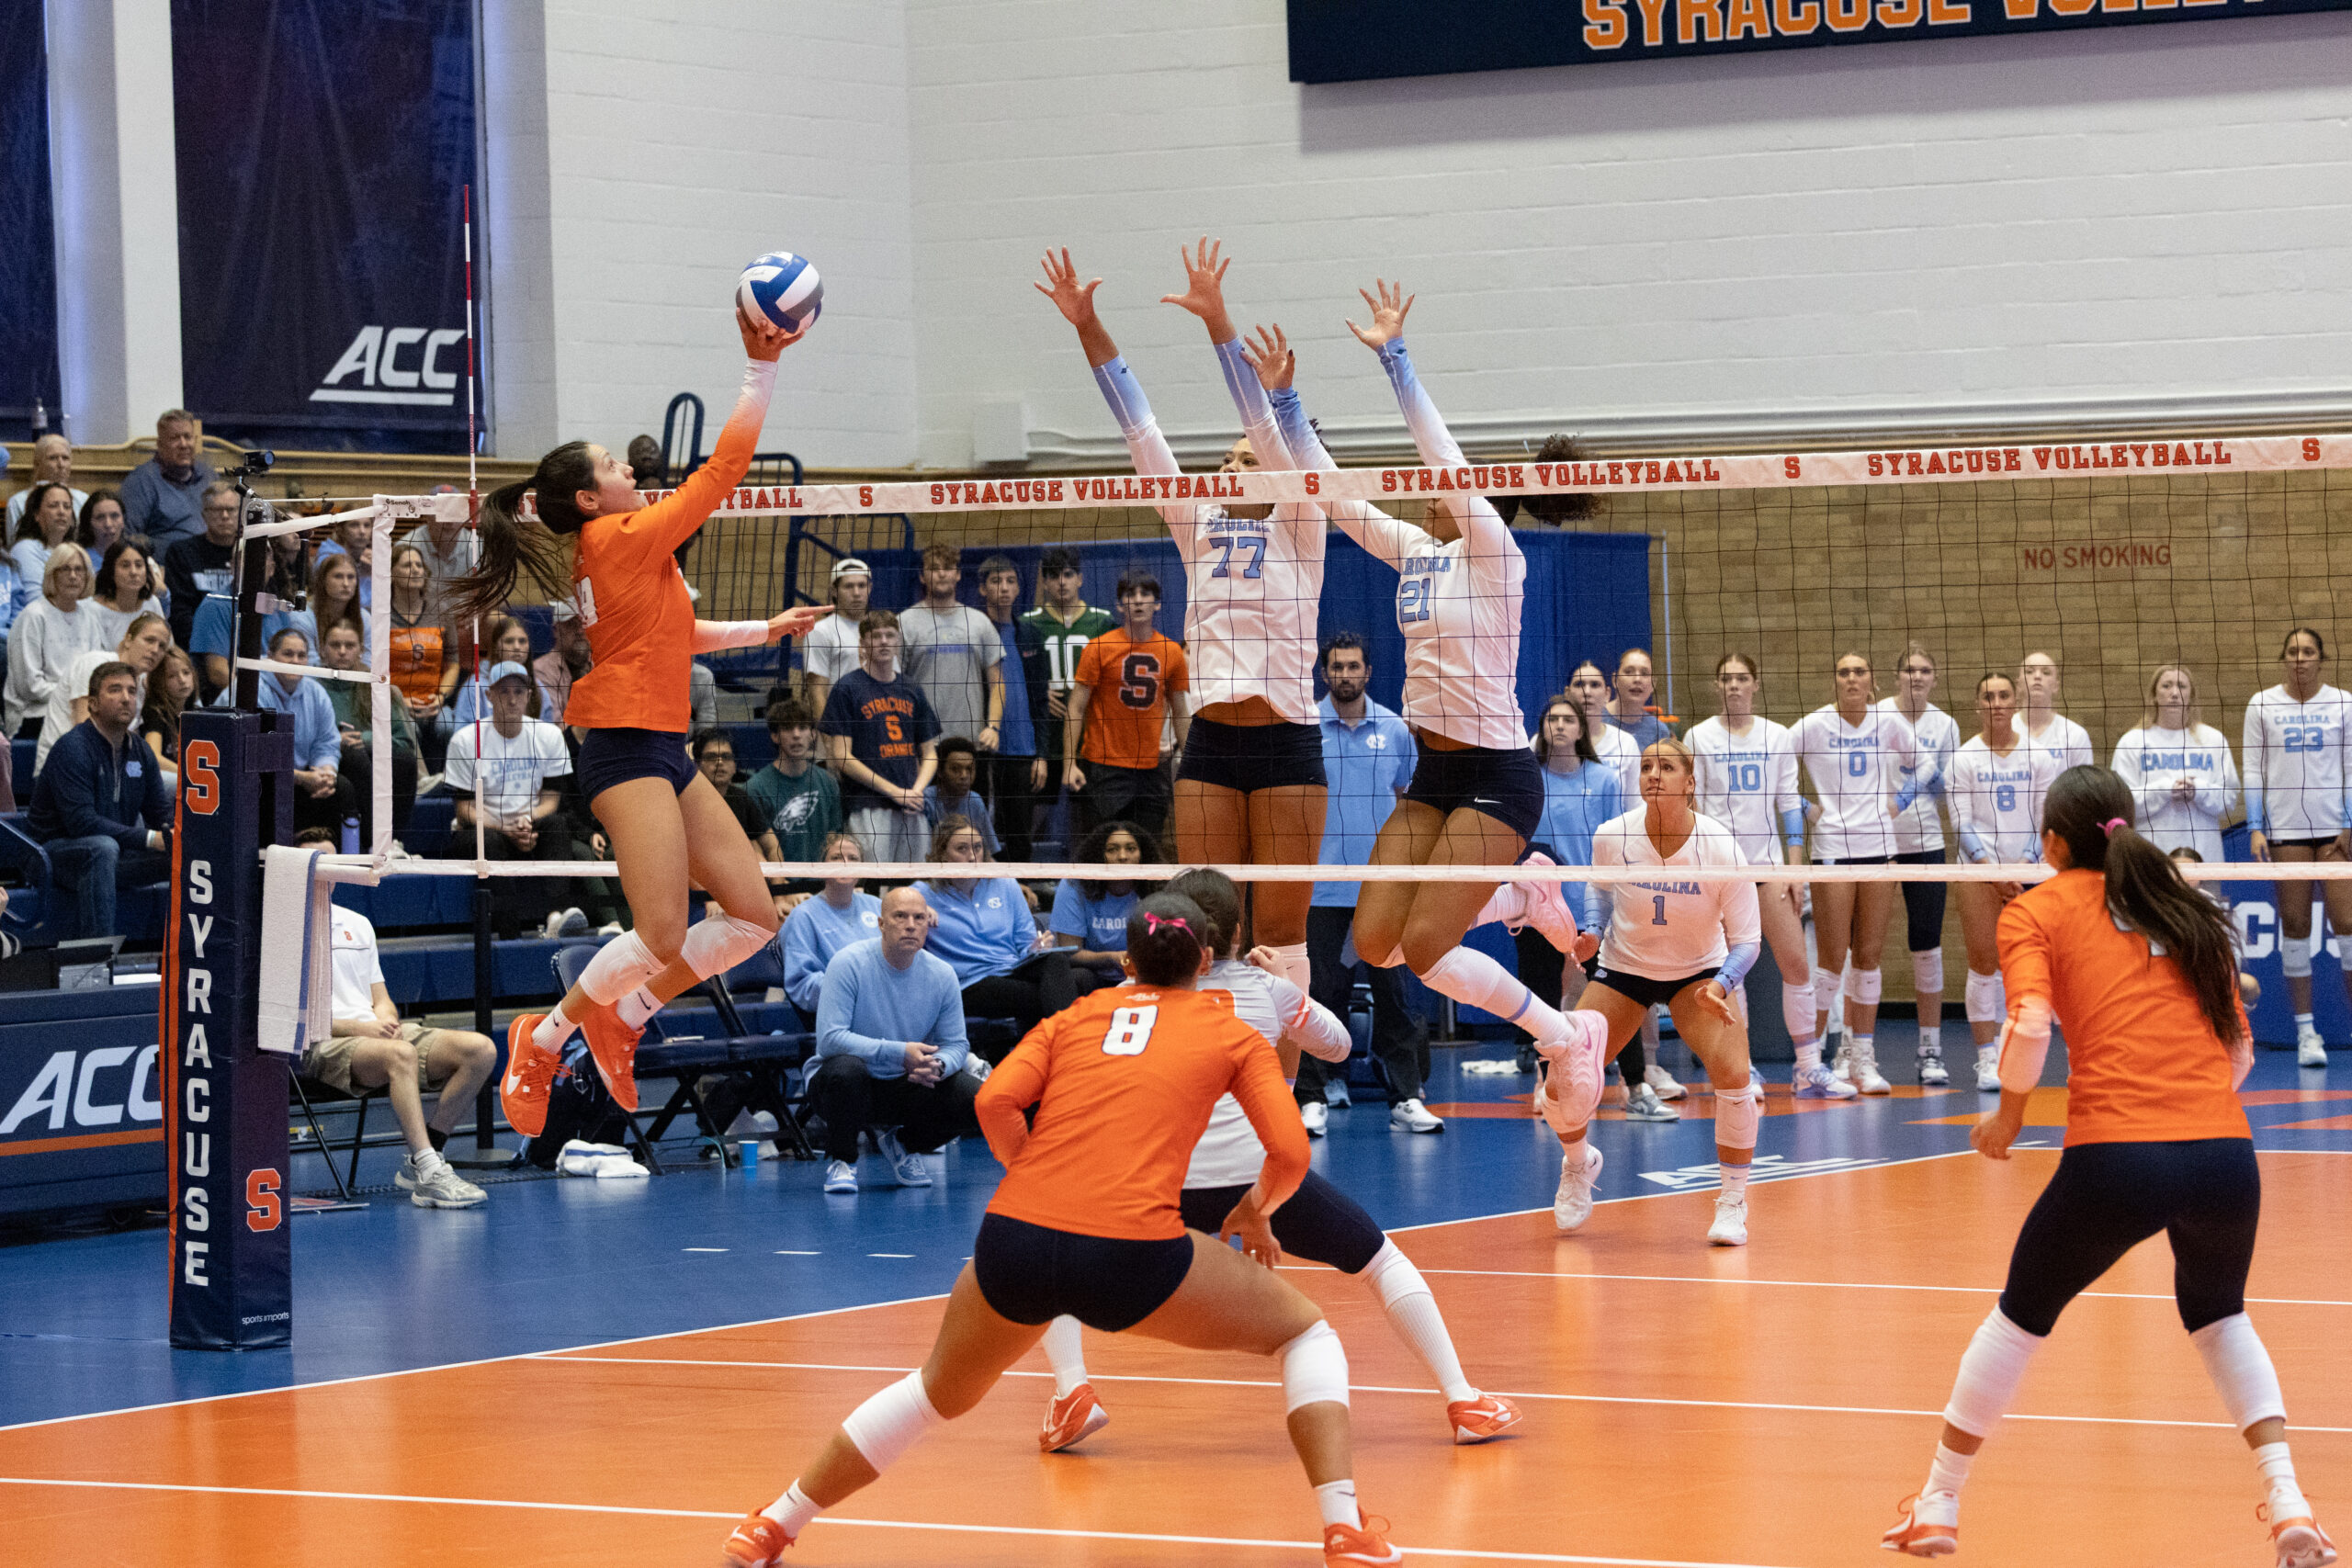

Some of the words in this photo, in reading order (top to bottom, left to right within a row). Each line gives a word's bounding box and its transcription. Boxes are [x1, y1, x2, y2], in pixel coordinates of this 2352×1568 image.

[322, 325, 467, 389] ACC
[1868, 448, 2021, 476] SYRACUSE
[2032, 441, 2232, 469] VOLLEYBALL
[2302, 438, 2320, 461] S
[1382, 466, 1524, 491] SYRACUSE
[1536, 459, 1720, 487] VOLLEYBALL
[1784, 456, 1801, 479] S
[859, 485, 873, 507] S
[931, 480, 1063, 504] SYRACUSE
[1073, 475, 1244, 500] VOLLEYBALL
[1305, 472, 1320, 495] S
[644, 487, 802, 510] VYBALL
[1208, 536, 1267, 579] 77
[2024, 548, 2054, 570] NO
[2064, 545, 2171, 568] SMOKING
[1400, 578, 1430, 623] 21
[1045, 635, 1090, 689] 10
[1119, 652, 1160, 710] S
[861, 696, 914, 720] SYRACUSE
[2274, 714, 2331, 725] CAROLINA
[879, 742, 915, 759] ORANGE
[1828, 736, 1880, 748] CAROLINA
[2284, 727, 2324, 752] 23
[1714, 751, 1770, 762] CAROLINA
[1849, 750, 1867, 777] 0
[2141, 752, 2213, 772] CAROLINA
[186, 739, 220, 816] S
[1728, 764, 1760, 792] 10
[1977, 771, 2032, 782] CAROLINA
[1996, 784, 2016, 812] 8
[1627, 882, 1702, 895] ROLINA
[1652, 895, 1668, 925] 1
[1102, 1004, 1158, 1055] 8
[185, 859, 214, 1286] SYRACUSE
[0, 1043, 163, 1134] ACC
[246, 1168, 282, 1232] S
[242, 1315, 264, 1325] sports
[264, 1312, 289, 1323] imports
